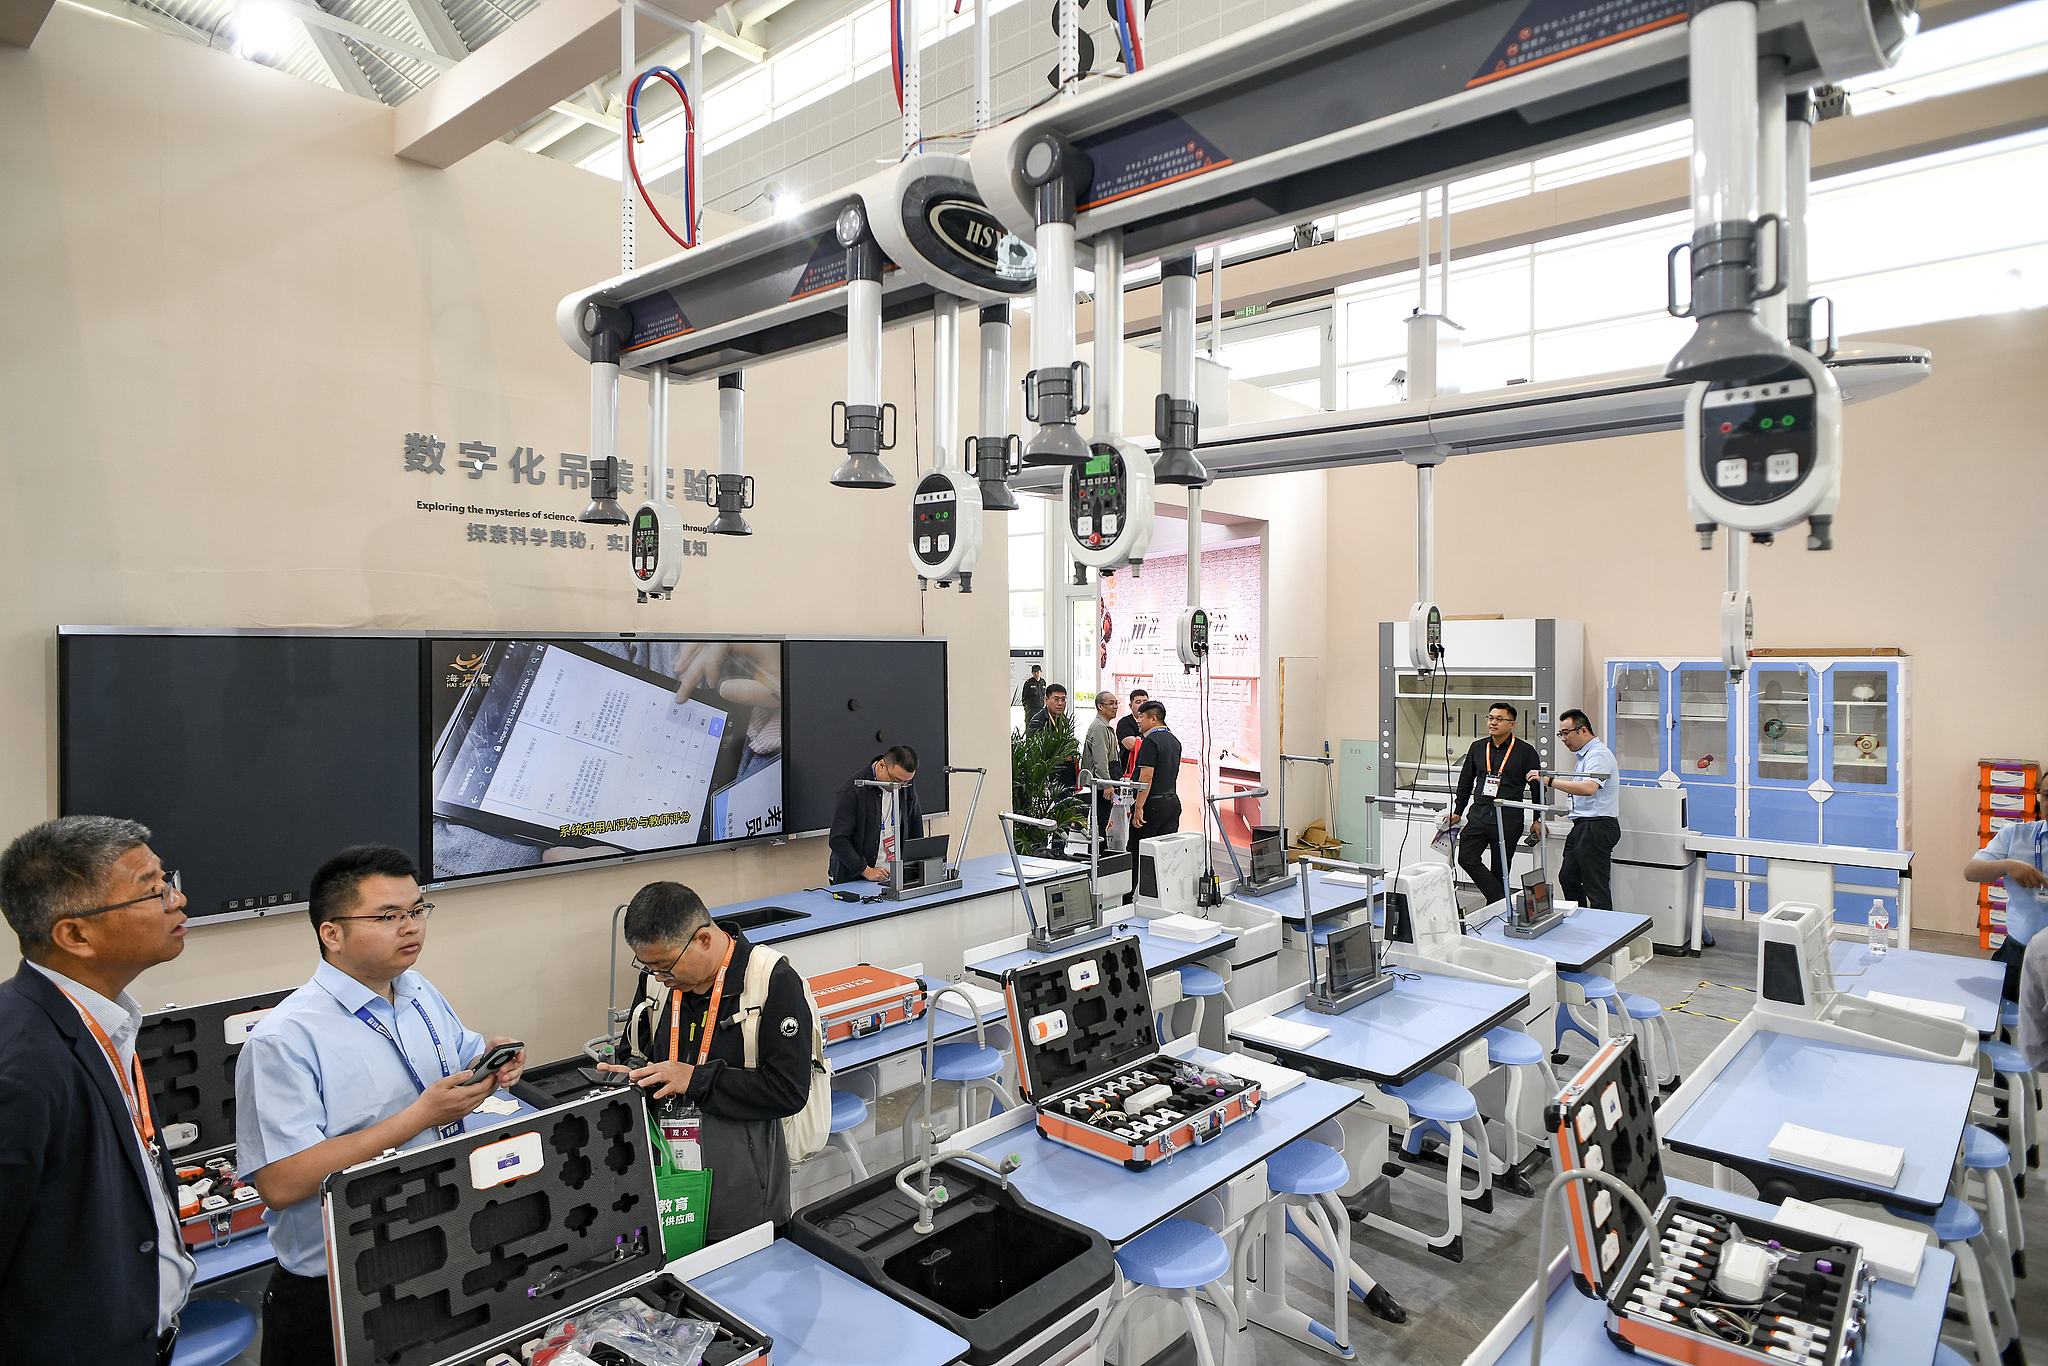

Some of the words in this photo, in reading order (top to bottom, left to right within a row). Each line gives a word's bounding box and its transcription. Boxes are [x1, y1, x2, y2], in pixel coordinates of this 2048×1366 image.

[416, 501, 465, 515] Exploring
[467, 505, 484, 514] the
[486, 507, 531, 518] mysteries
[532, 511, 542, 519] of
[543, 513, 578, 522] science,
[559, 811, 691, 838] 系统采用AI评分与教师评分
[659, 1197, 689, 1213] 教育
